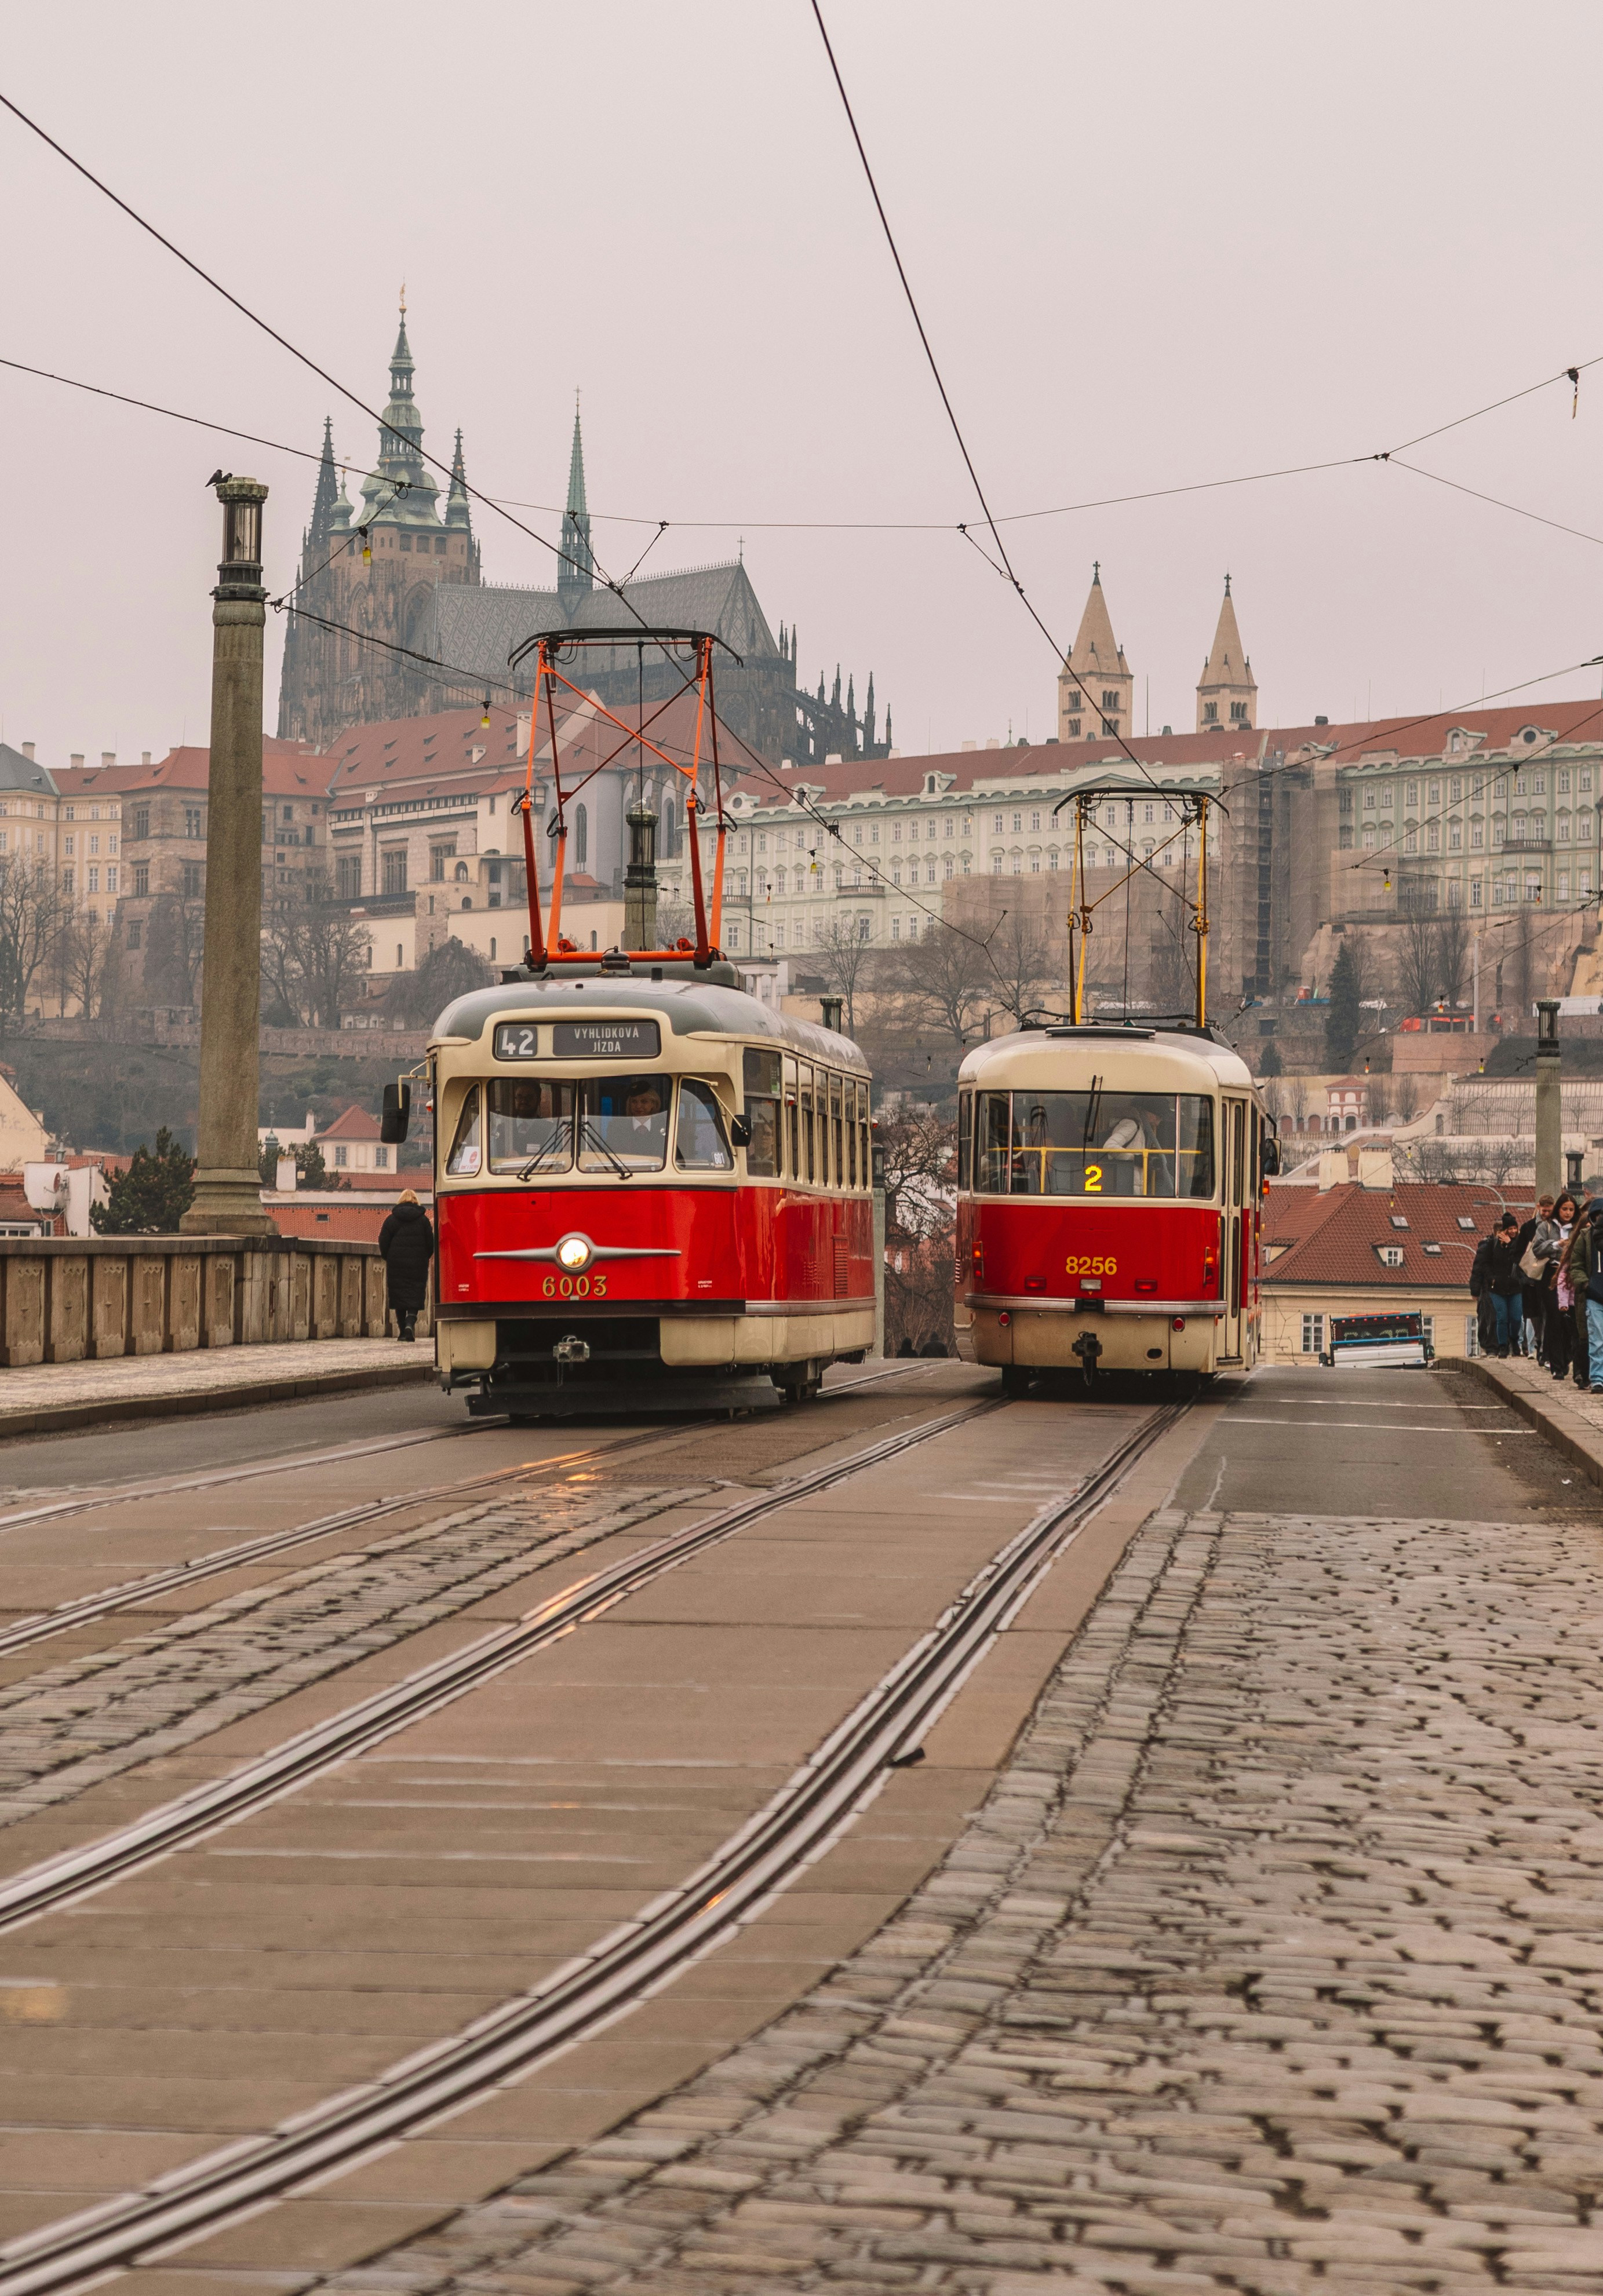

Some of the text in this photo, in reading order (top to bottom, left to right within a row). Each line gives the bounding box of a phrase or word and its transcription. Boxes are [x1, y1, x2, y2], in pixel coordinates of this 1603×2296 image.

[501, 1029, 533, 1055] 42
[574, 1025, 639, 1039] VYHLÍDKOVÁ
[593, 1039, 621, 1053] JÍZDA
[1084, 1165, 1102, 1191] 2
[1065, 1256, 1117, 1275] 8256
[542, 1276, 607, 1297] 6003
